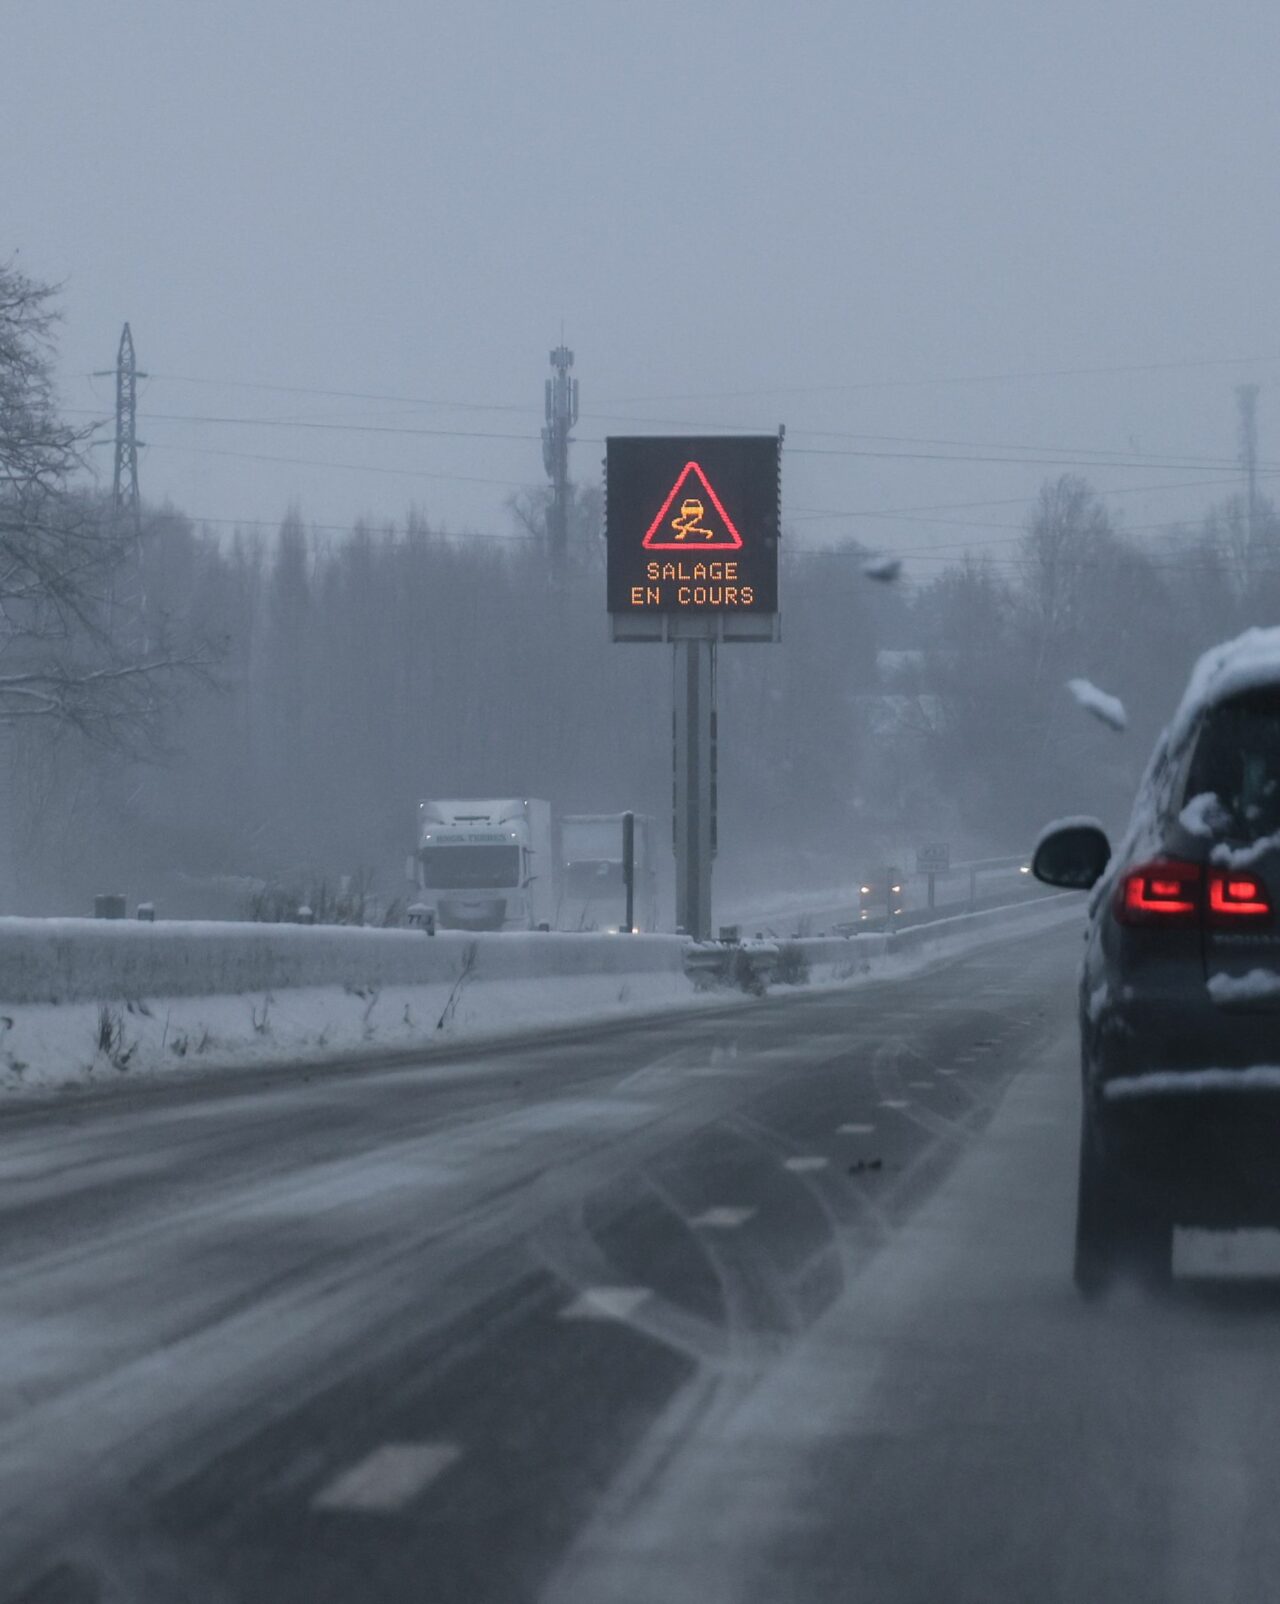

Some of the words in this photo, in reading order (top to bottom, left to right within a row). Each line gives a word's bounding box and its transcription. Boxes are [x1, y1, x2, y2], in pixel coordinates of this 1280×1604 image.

[646, 562, 738, 580] SALAGE
[631, 586, 660, 605] EN
[678, 586, 754, 605] COURS
